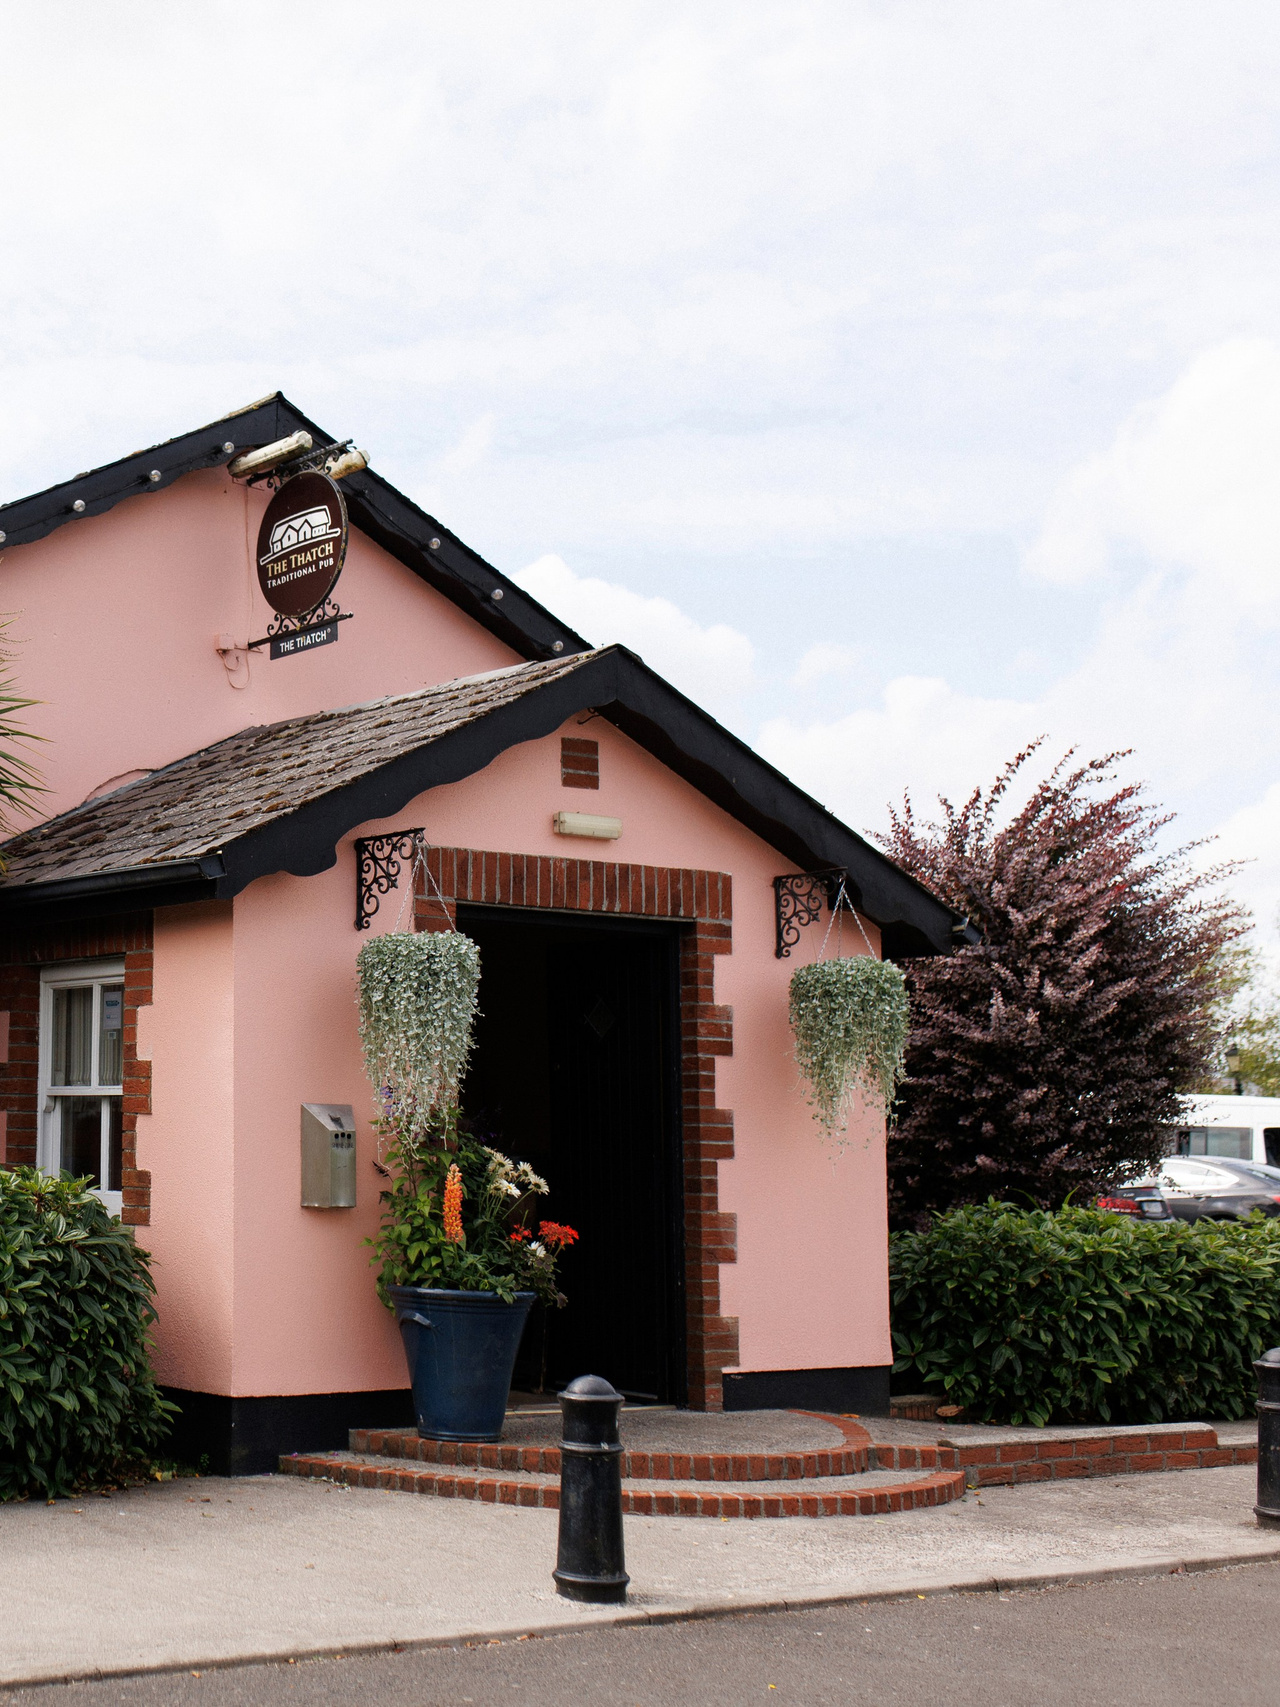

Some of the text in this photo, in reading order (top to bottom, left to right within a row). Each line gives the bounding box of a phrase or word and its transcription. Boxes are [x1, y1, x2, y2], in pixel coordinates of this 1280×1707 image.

[266, 541, 334, 577] THE THATCH
[267, 557, 334, 589] TRADITIONAL PUB
[280, 630, 327, 653] THE THATCH
